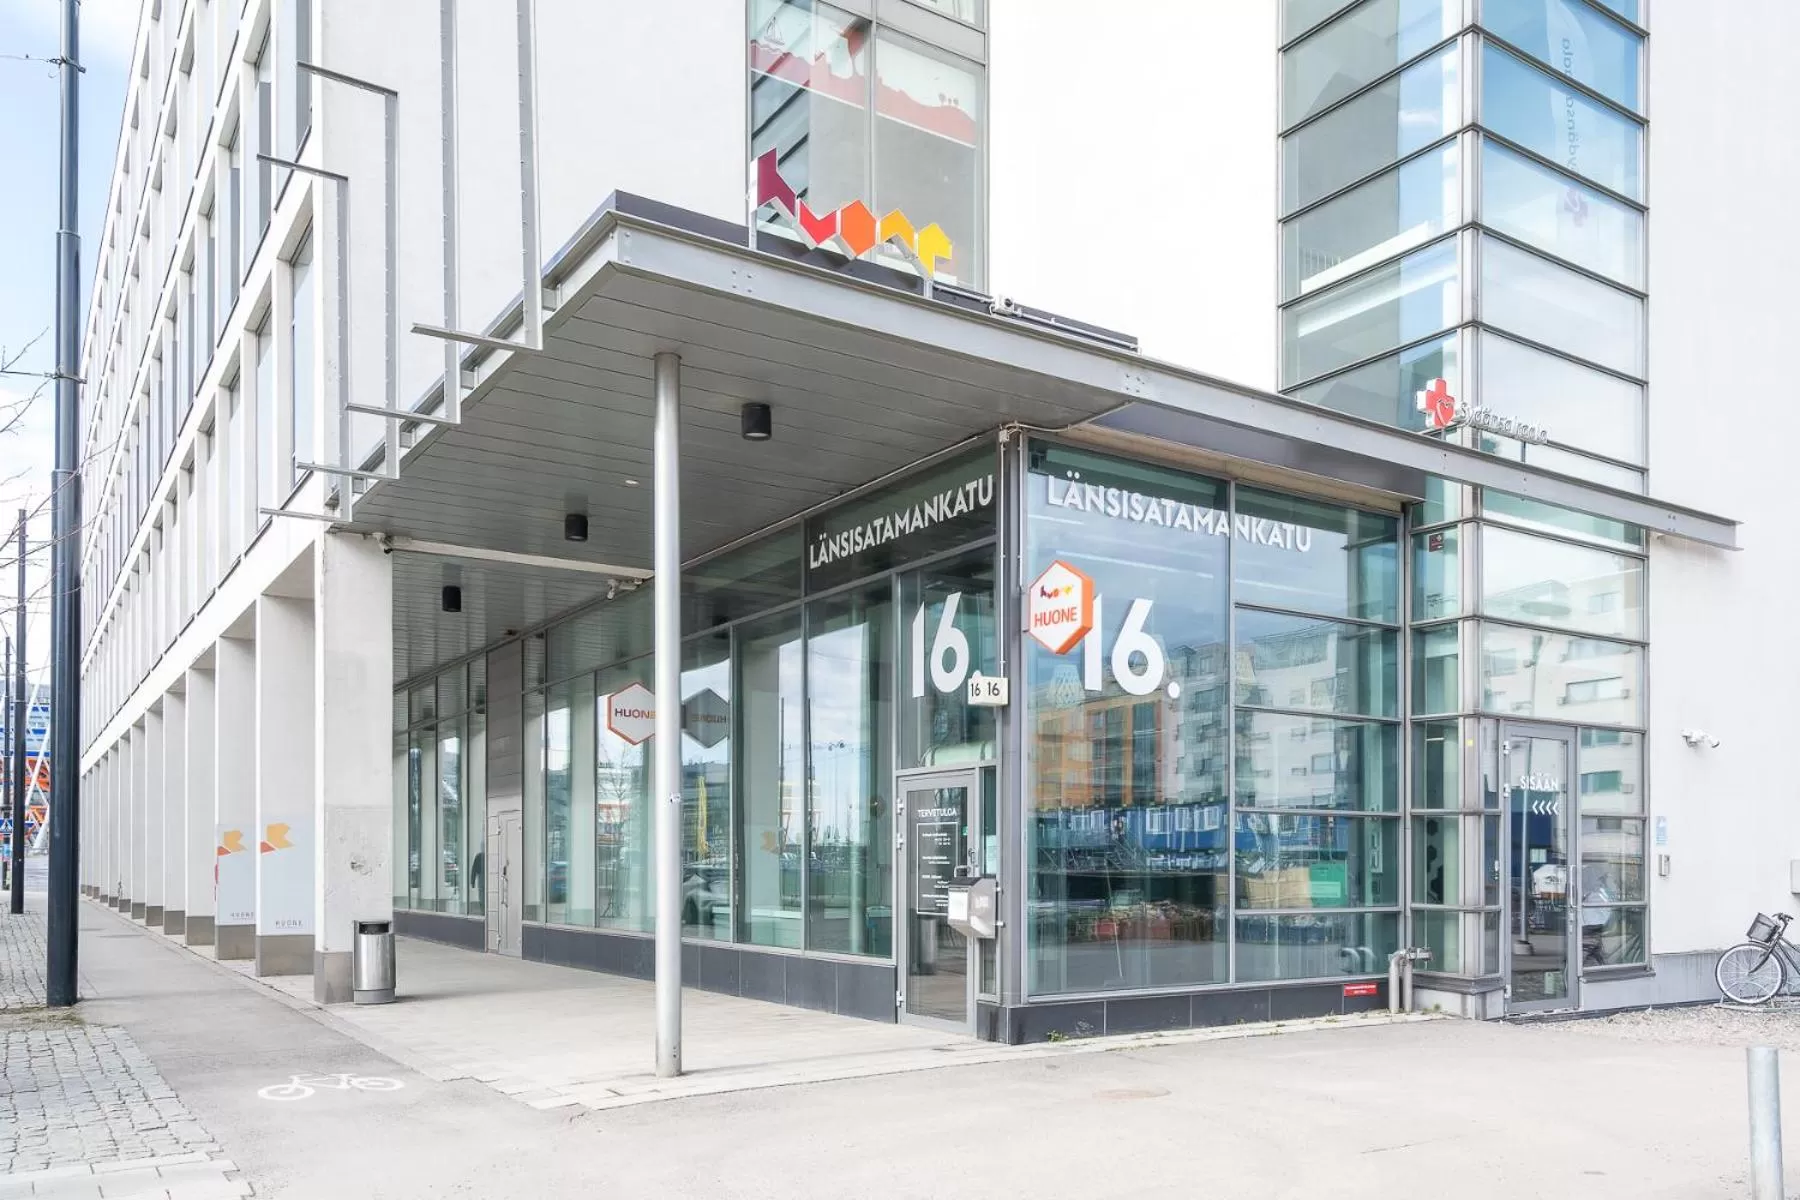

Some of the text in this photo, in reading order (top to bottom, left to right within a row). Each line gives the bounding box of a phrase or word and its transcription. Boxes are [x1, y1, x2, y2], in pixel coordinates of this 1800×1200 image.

[809, 474, 993, 569] LÄNSISATAMANKATU
[1048, 470, 1312, 552] LÄNSISATAMANKATU
[1034, 607, 1077, 627] HUONE
[1084, 593, 1180, 699] 16.
[971, 683, 980, 697] 16
[987, 682, 1000, 697] 16
